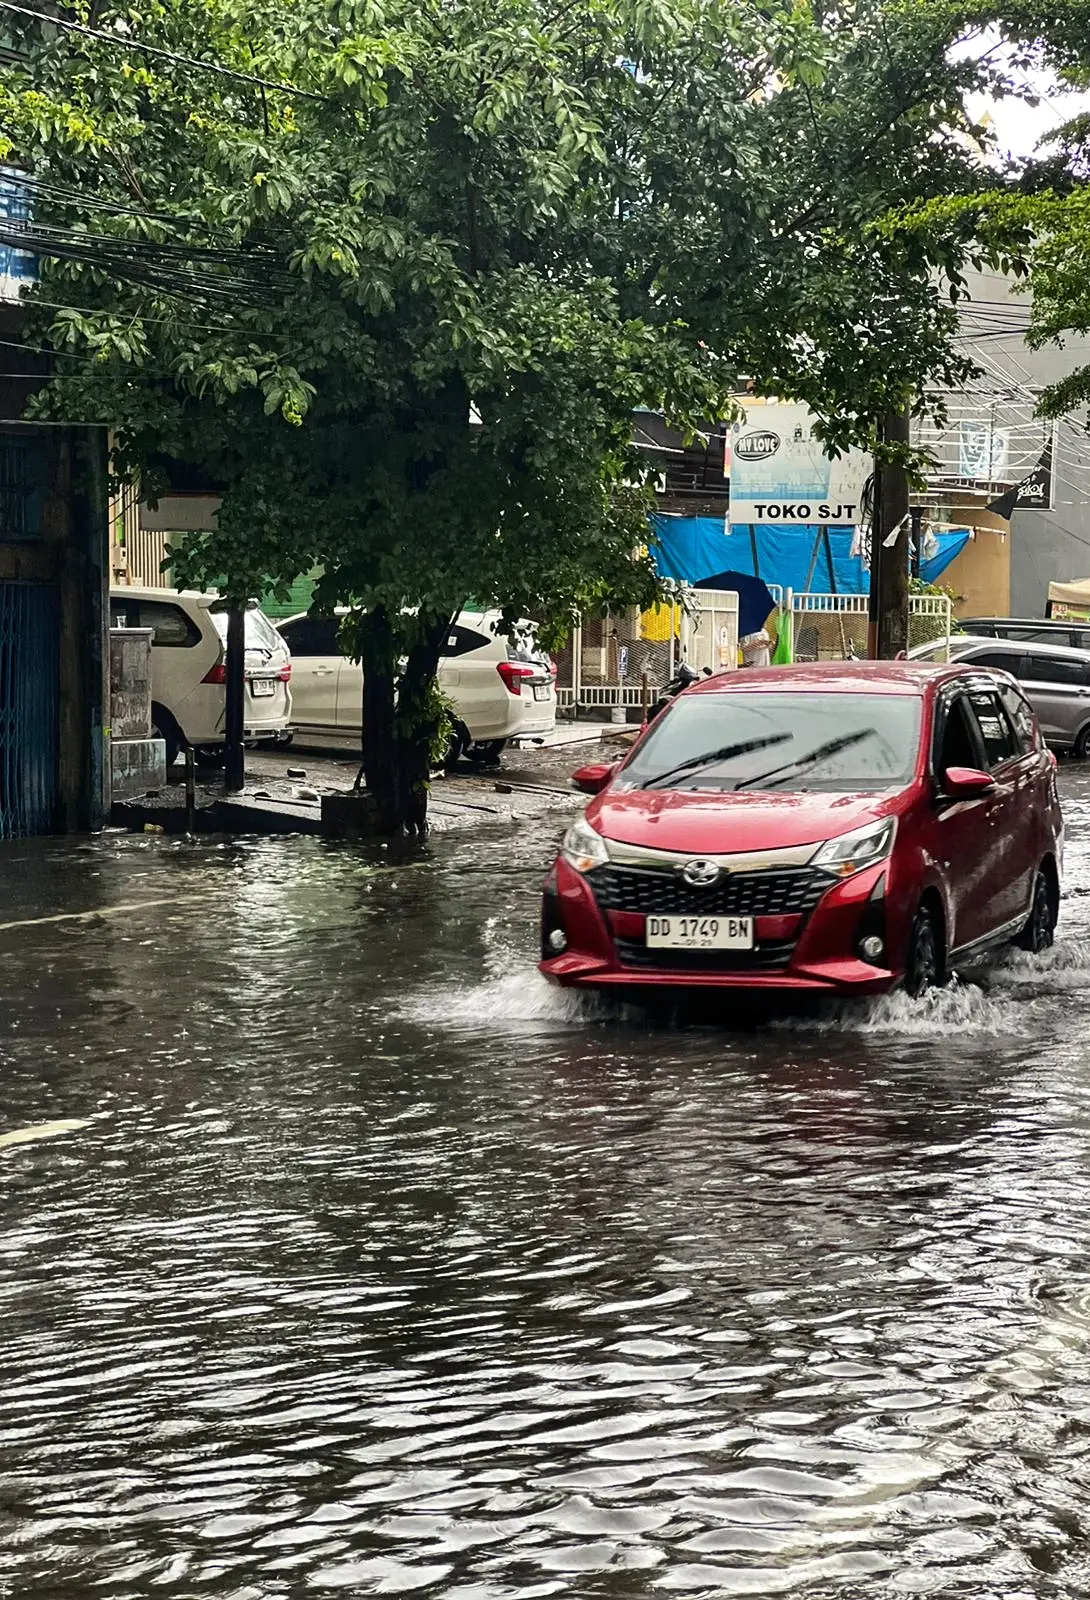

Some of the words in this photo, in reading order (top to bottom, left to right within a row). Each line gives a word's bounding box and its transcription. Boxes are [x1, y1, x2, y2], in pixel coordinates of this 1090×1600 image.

[738, 438, 752, 452] MY
[753, 437, 777, 452] LOVE
[754, 504, 811, 519] TOKO
[818, 504, 856, 519] SJT
[650, 918, 671, 936] DD
[679, 919, 719, 937] 1749
[728, 919, 748, 937] BN
